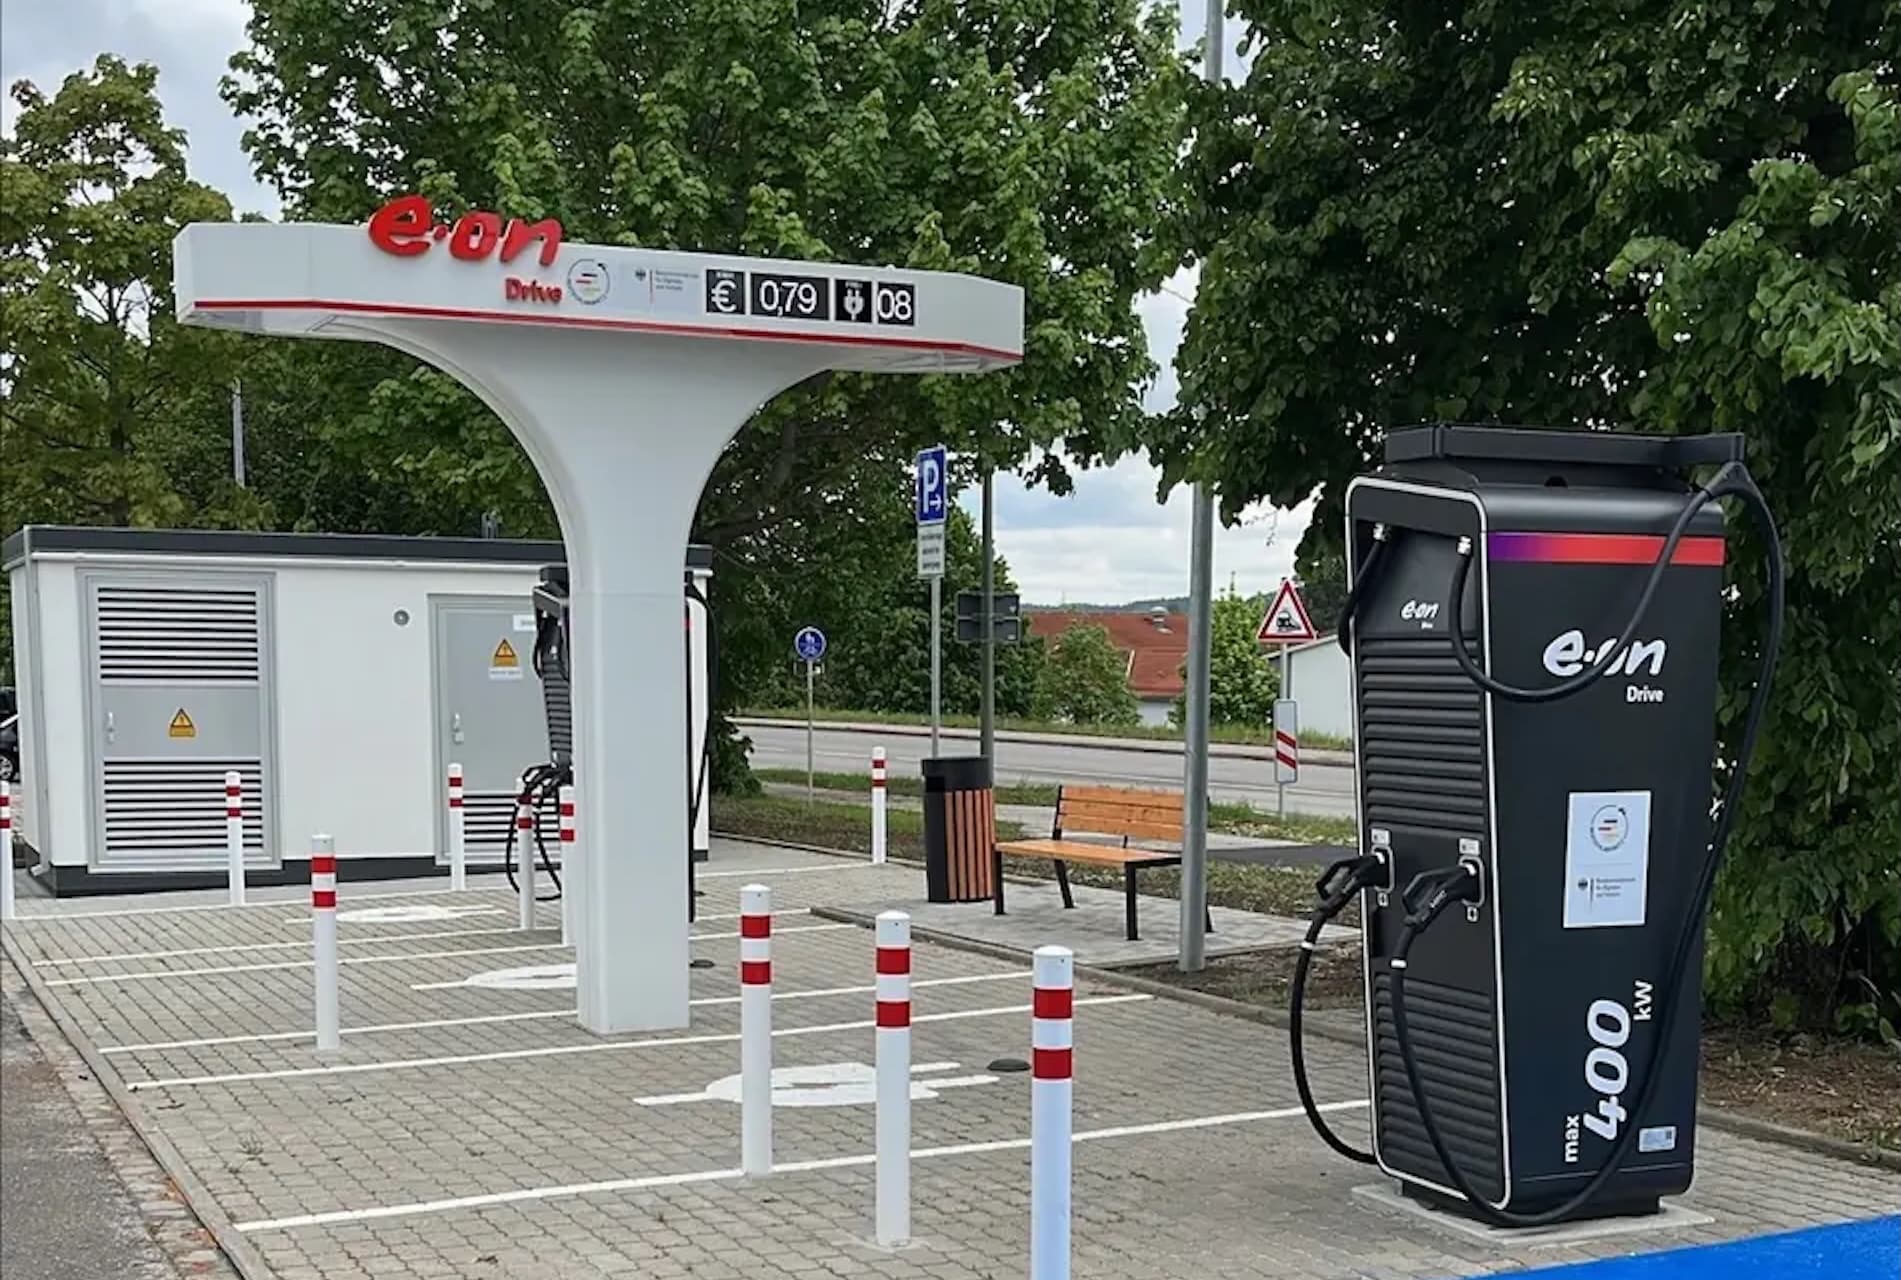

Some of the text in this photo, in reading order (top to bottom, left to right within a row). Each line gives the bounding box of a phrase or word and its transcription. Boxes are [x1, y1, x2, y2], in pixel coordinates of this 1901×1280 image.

[505, 277, 562, 305] Drive
[710, 279, 737, 312] €
[759, 279, 817, 317] 0,79
[877, 287, 912, 320] 08
[922, 459, 940, 514] P
[1626, 684, 1664, 703] Drive
[1634, 979, 1653, 1021] kW
[1583, 999, 1631, 1140] 400
[1564, 1114, 1580, 1163] max
